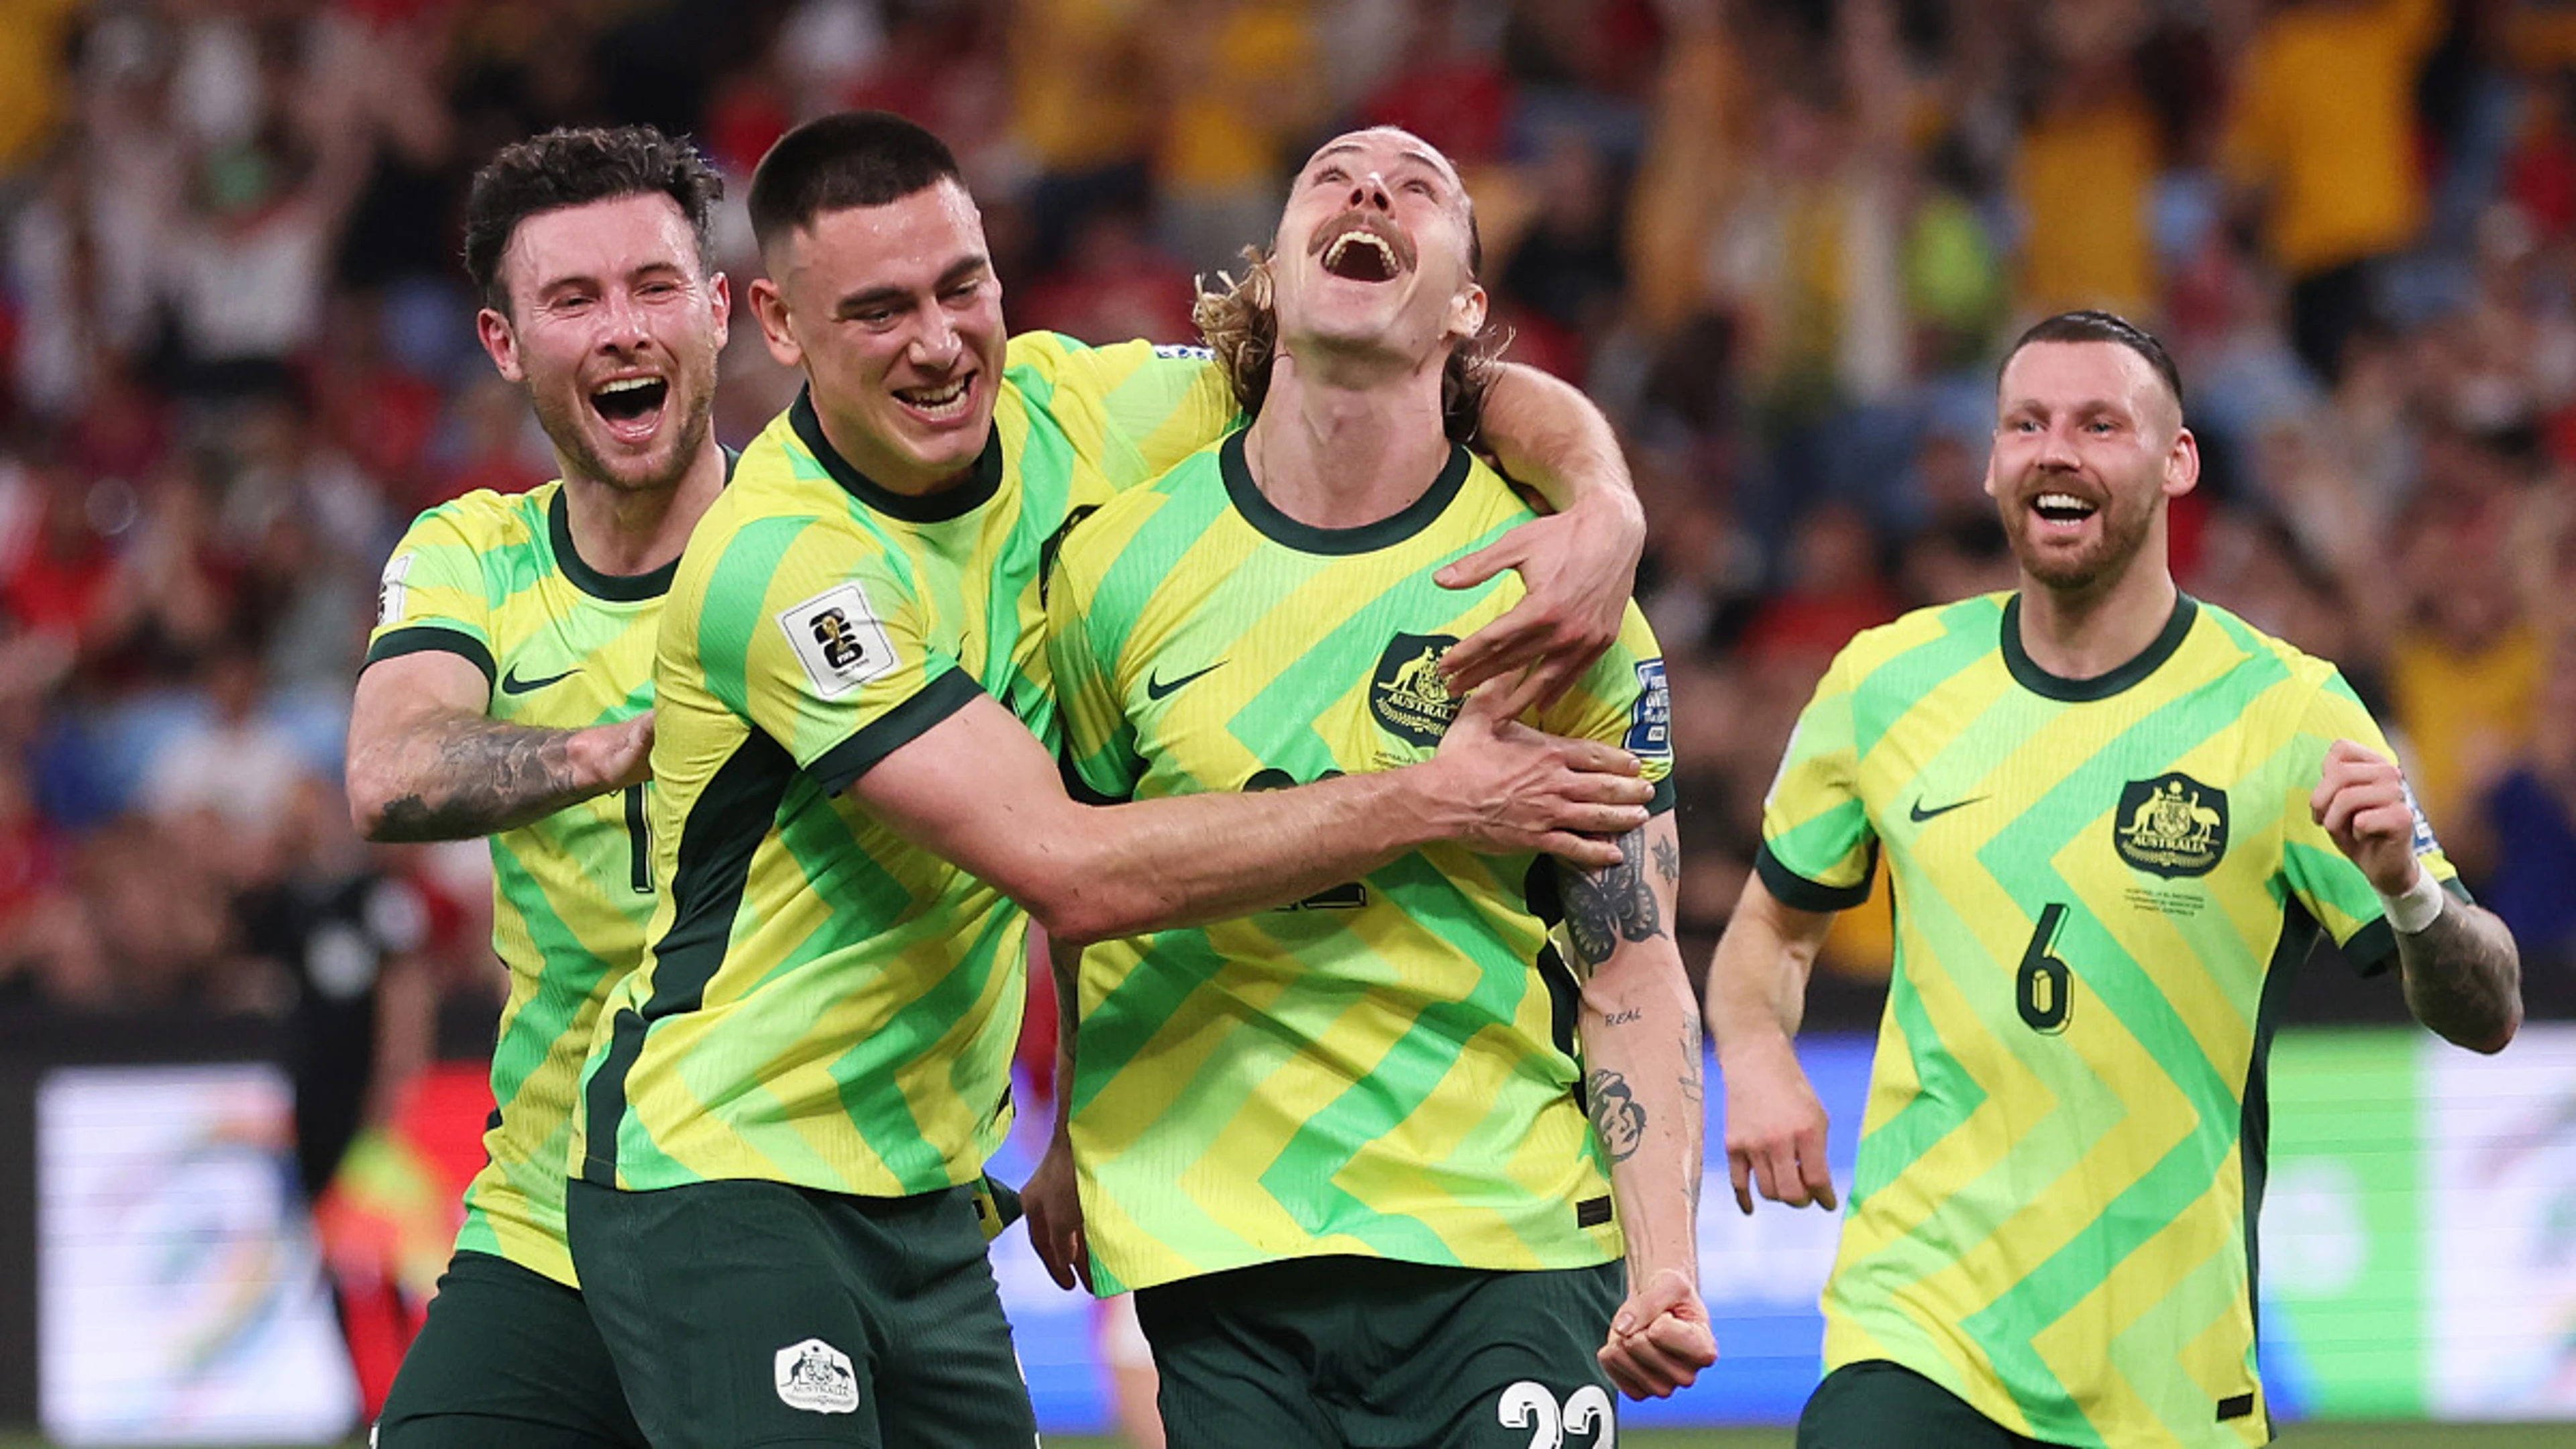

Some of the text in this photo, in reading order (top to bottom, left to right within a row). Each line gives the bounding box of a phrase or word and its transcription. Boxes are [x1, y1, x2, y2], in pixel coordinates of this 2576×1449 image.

[1388, 694, 1450, 720] AUSTRAL
[2133, 835, 2207, 853] AUSTRALIA
[2016, 903, 2074, 1036] 6
[1605, 1008, 1642, 1028] REAL
[793, 1385, 849, 1397] AUSTRALIA
